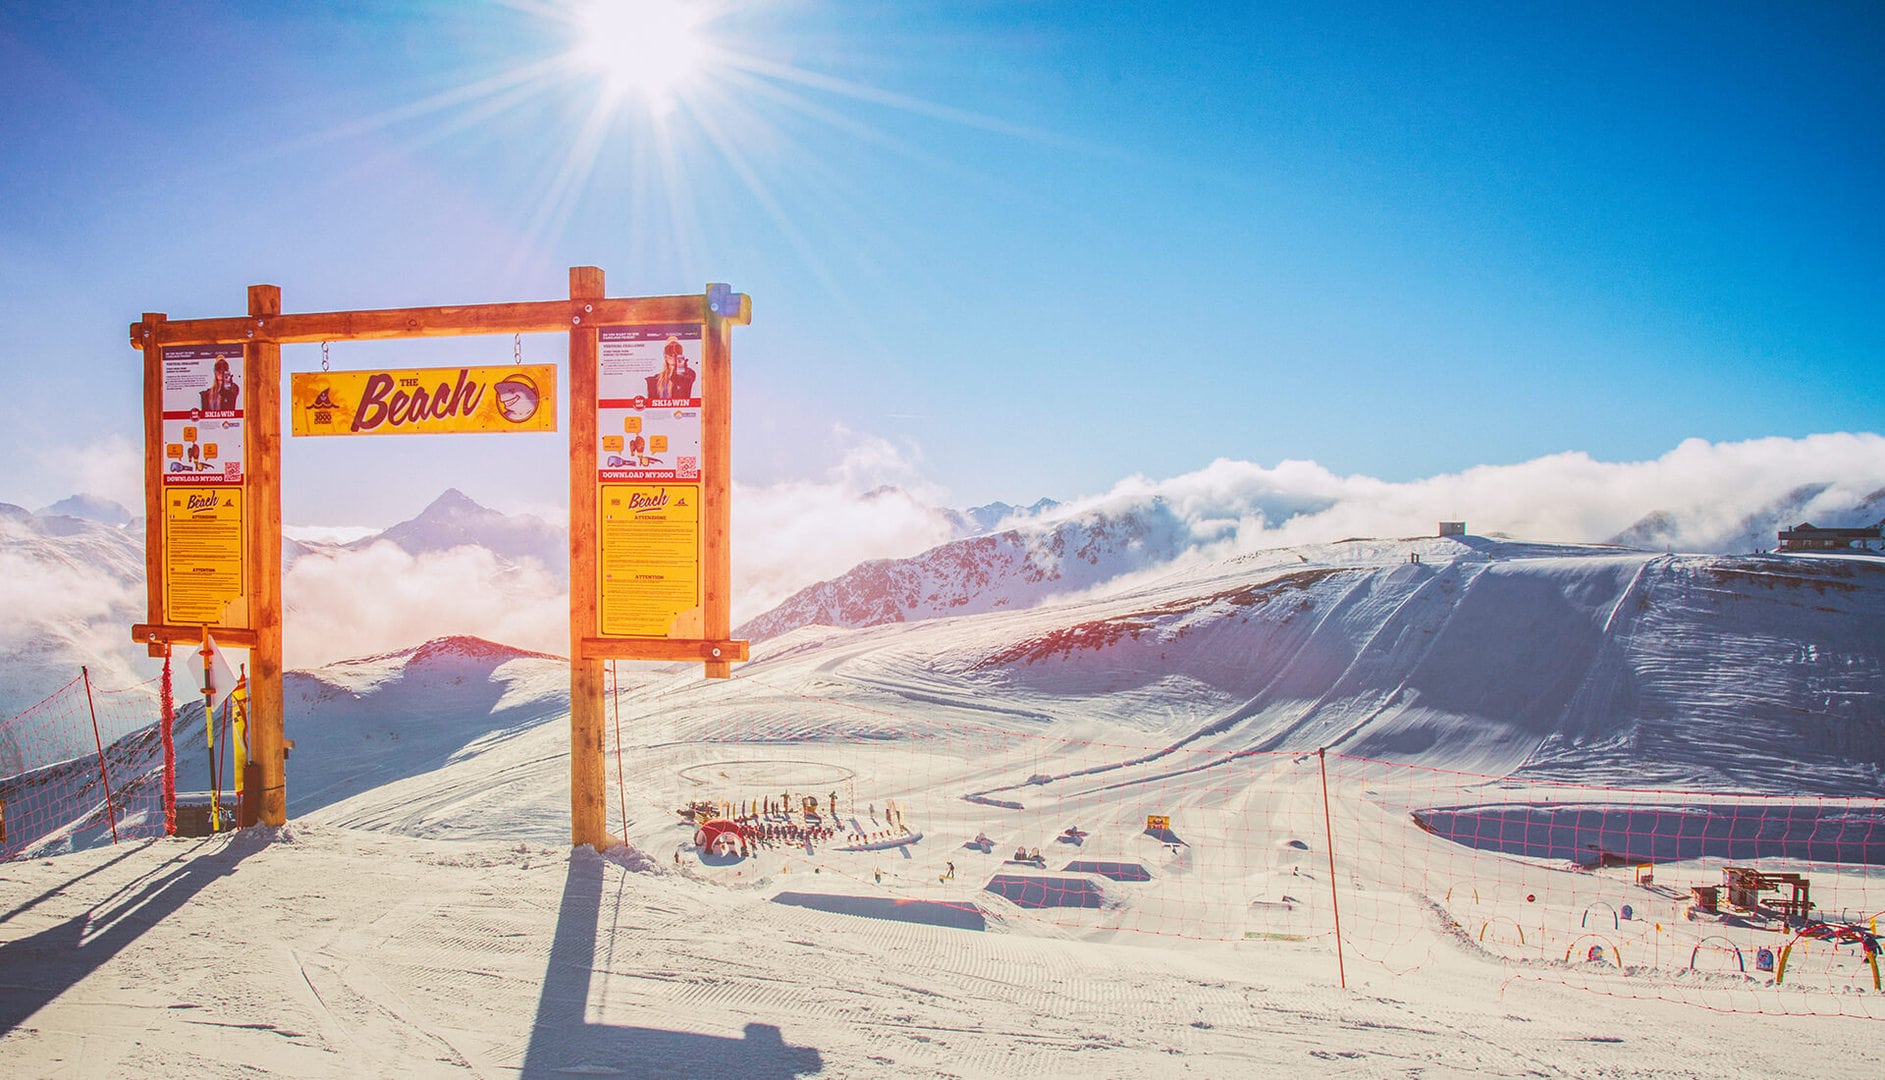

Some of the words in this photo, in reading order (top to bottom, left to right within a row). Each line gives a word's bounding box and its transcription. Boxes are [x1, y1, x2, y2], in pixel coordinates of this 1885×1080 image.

[400, 378, 418, 386] THE
[350, 369, 486, 432] Beach
[187, 490, 219, 510] Beach
[628, 488, 668, 510] Beach
